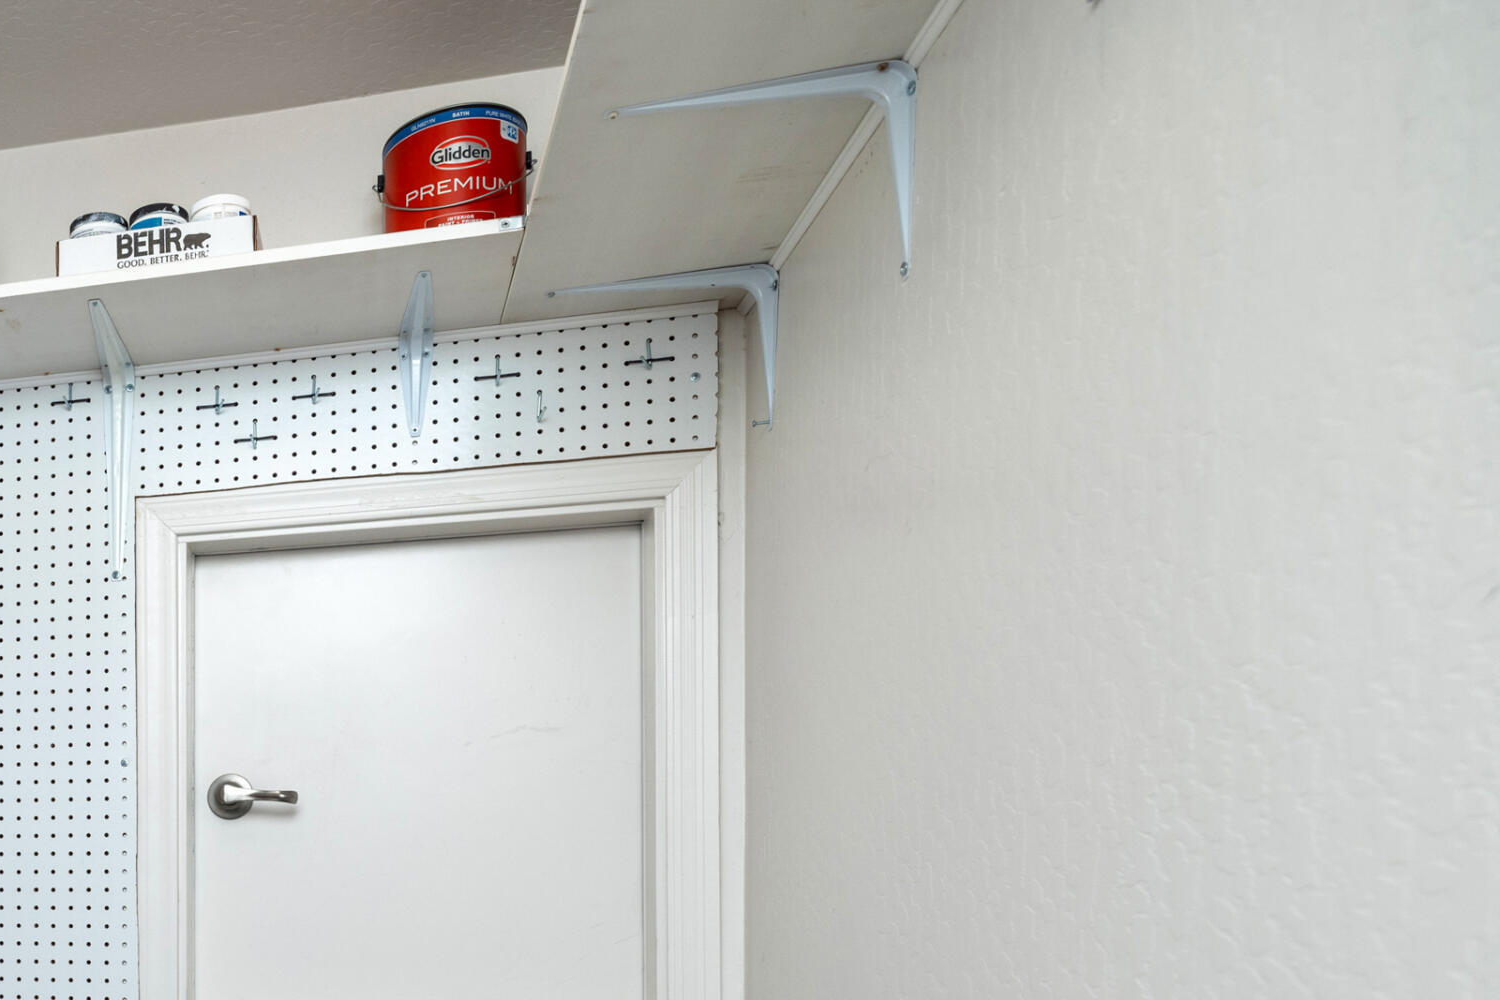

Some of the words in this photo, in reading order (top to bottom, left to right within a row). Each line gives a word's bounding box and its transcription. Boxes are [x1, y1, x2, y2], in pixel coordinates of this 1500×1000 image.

[431, 144, 490, 165] Glidden
[405, 175, 513, 207] PREMIUM
[116, 227, 182, 260] BEHR
